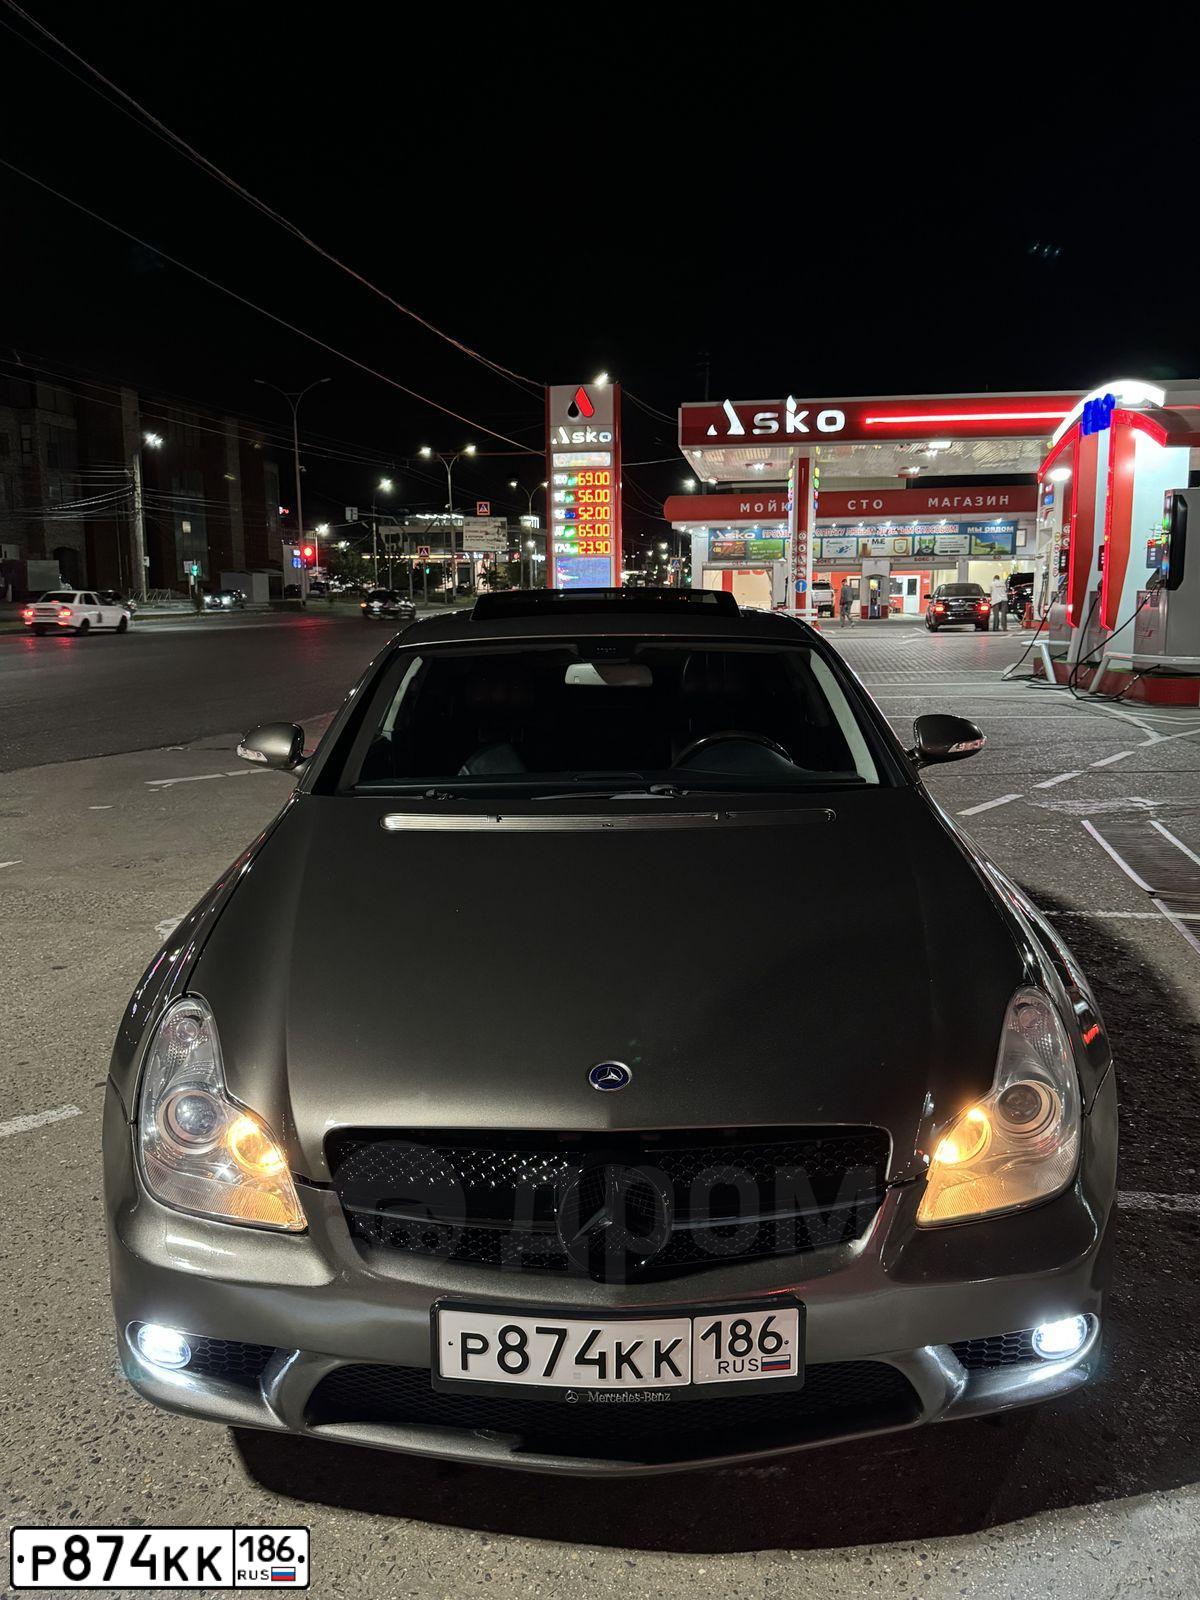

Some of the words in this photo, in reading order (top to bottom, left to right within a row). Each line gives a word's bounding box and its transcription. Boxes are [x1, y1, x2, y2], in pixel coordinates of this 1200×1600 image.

[706, 395, 845, 436] Asko
[551, 425, 612, 445] Asko
[578, 471, 610, 486] 69.00
[578, 490, 610, 503] 56.00
[739, 499, 790, 512] МОЙК
[847, 499, 884, 511] СТО
[927, 495, 1010, 508] МАГАЗИН
[578, 506, 610, 520] 52.00
[578, 523, 610, 537] 65.00
[578, 541, 611, 554] 23.90
[698, 1315, 784, 1360] 186
[717, 1358, 760, 1374] RUS
[587, 1391, 672, 1403] Mercedes-Benz
